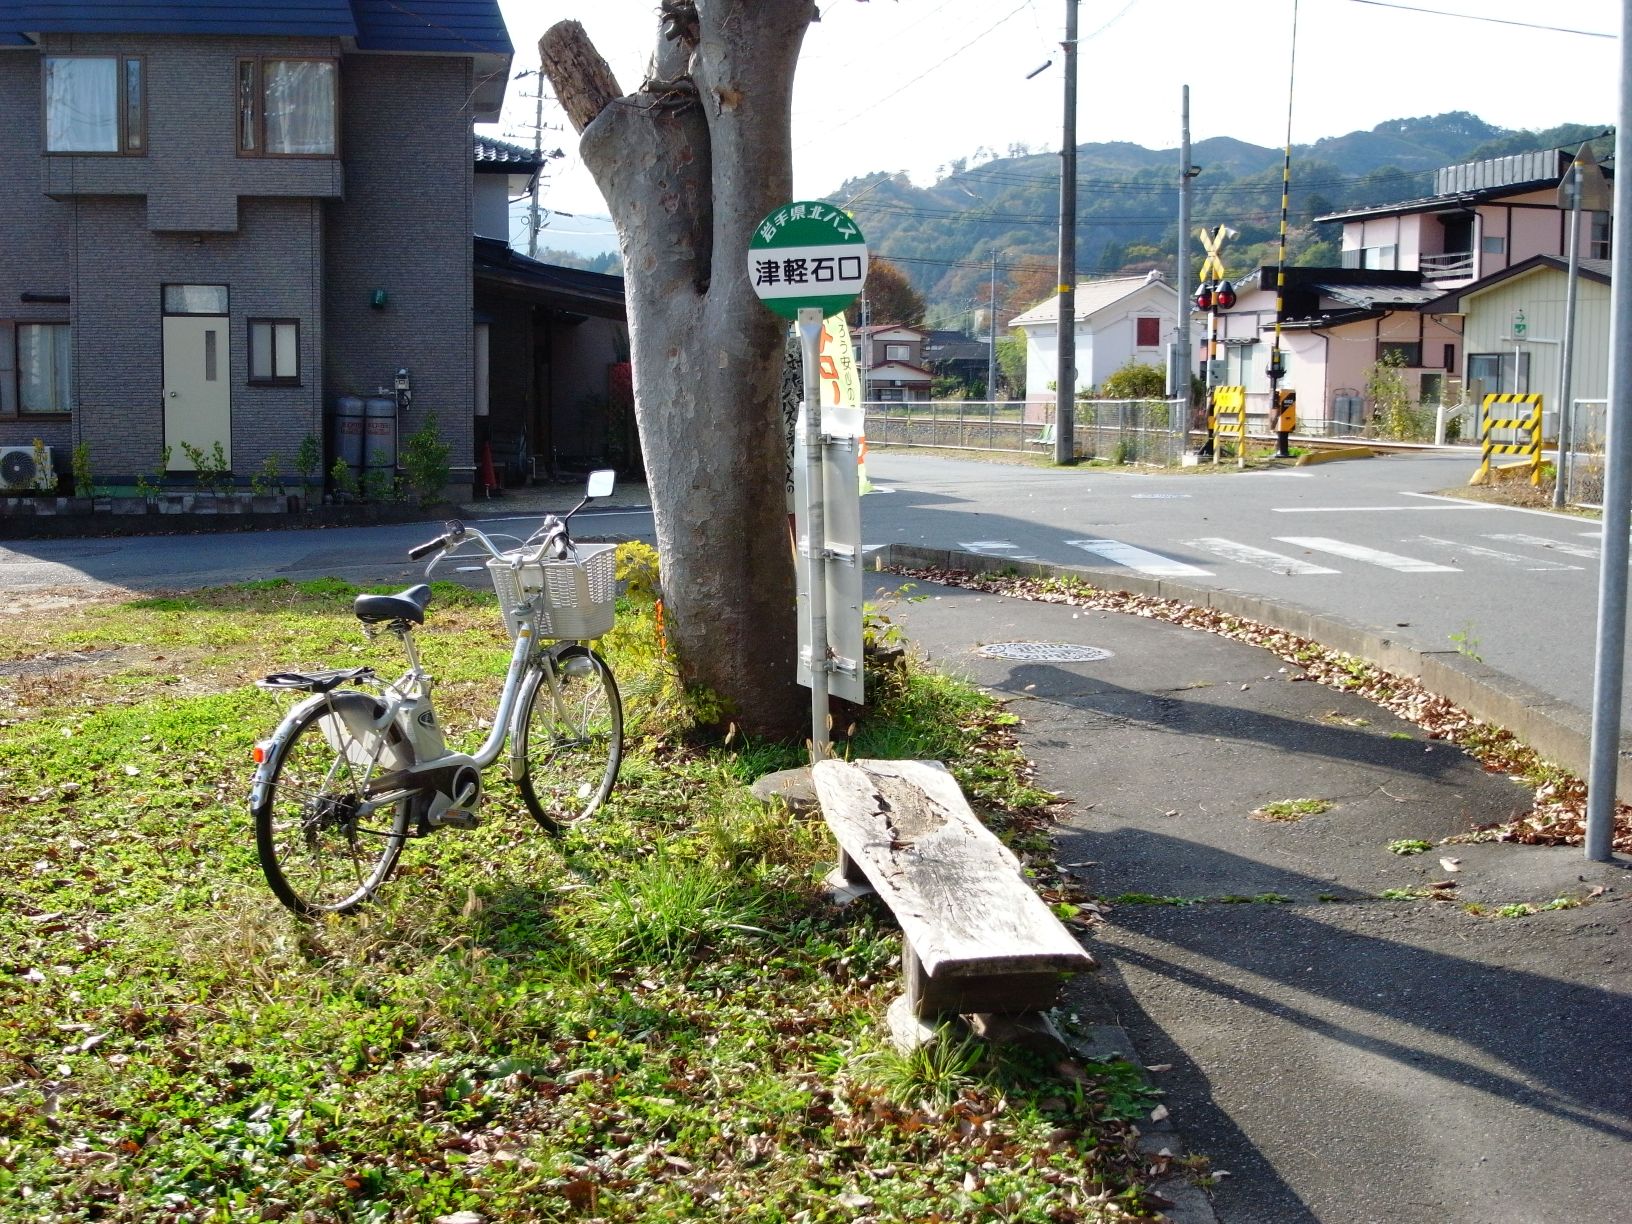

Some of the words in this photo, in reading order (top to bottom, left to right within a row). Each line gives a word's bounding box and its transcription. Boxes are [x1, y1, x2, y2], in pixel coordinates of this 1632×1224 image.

[760, 204, 857, 243] 岩手県北バス
[755, 256, 862, 287] 津軽石口
